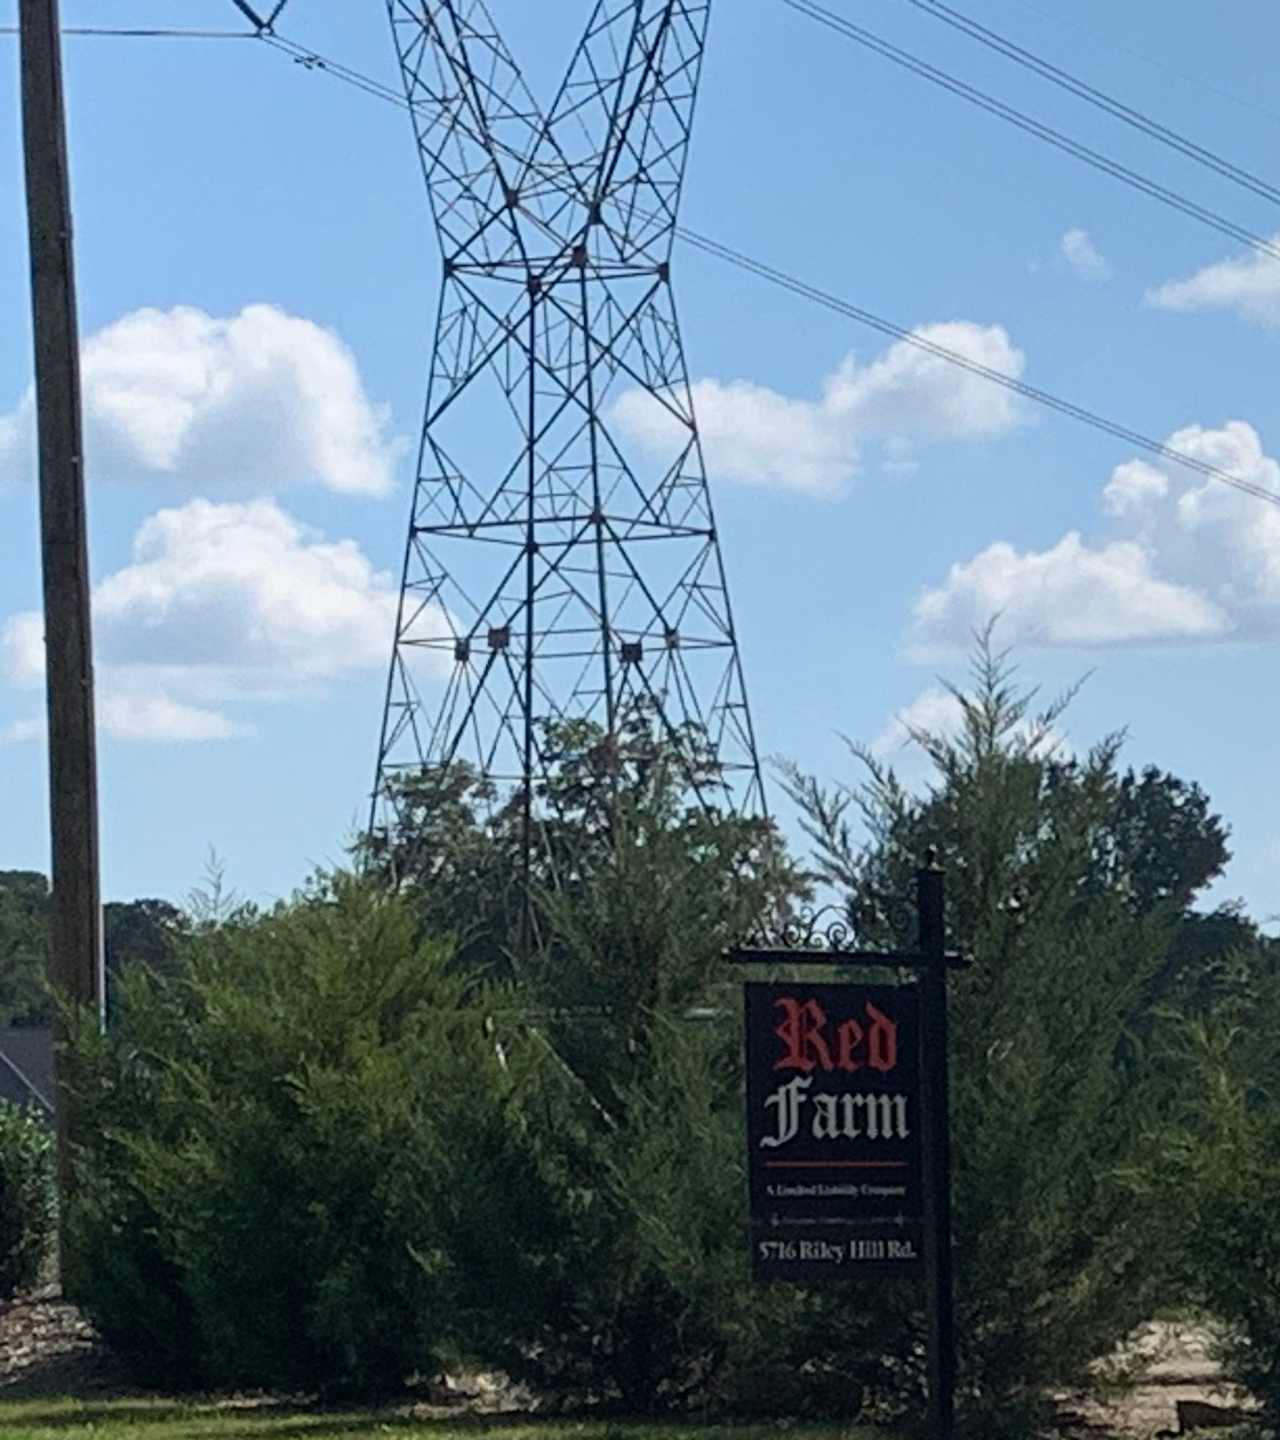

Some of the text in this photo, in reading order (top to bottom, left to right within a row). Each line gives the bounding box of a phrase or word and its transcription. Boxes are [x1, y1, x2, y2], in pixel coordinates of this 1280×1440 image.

[773, 997, 897, 1072] Red
[759, 1075, 912, 1148] Farm
[759, 1240, 797, 1261] 5716
[849, 1239, 884, 1260] Hill
[887, 1239, 917, 1260] Rd.
